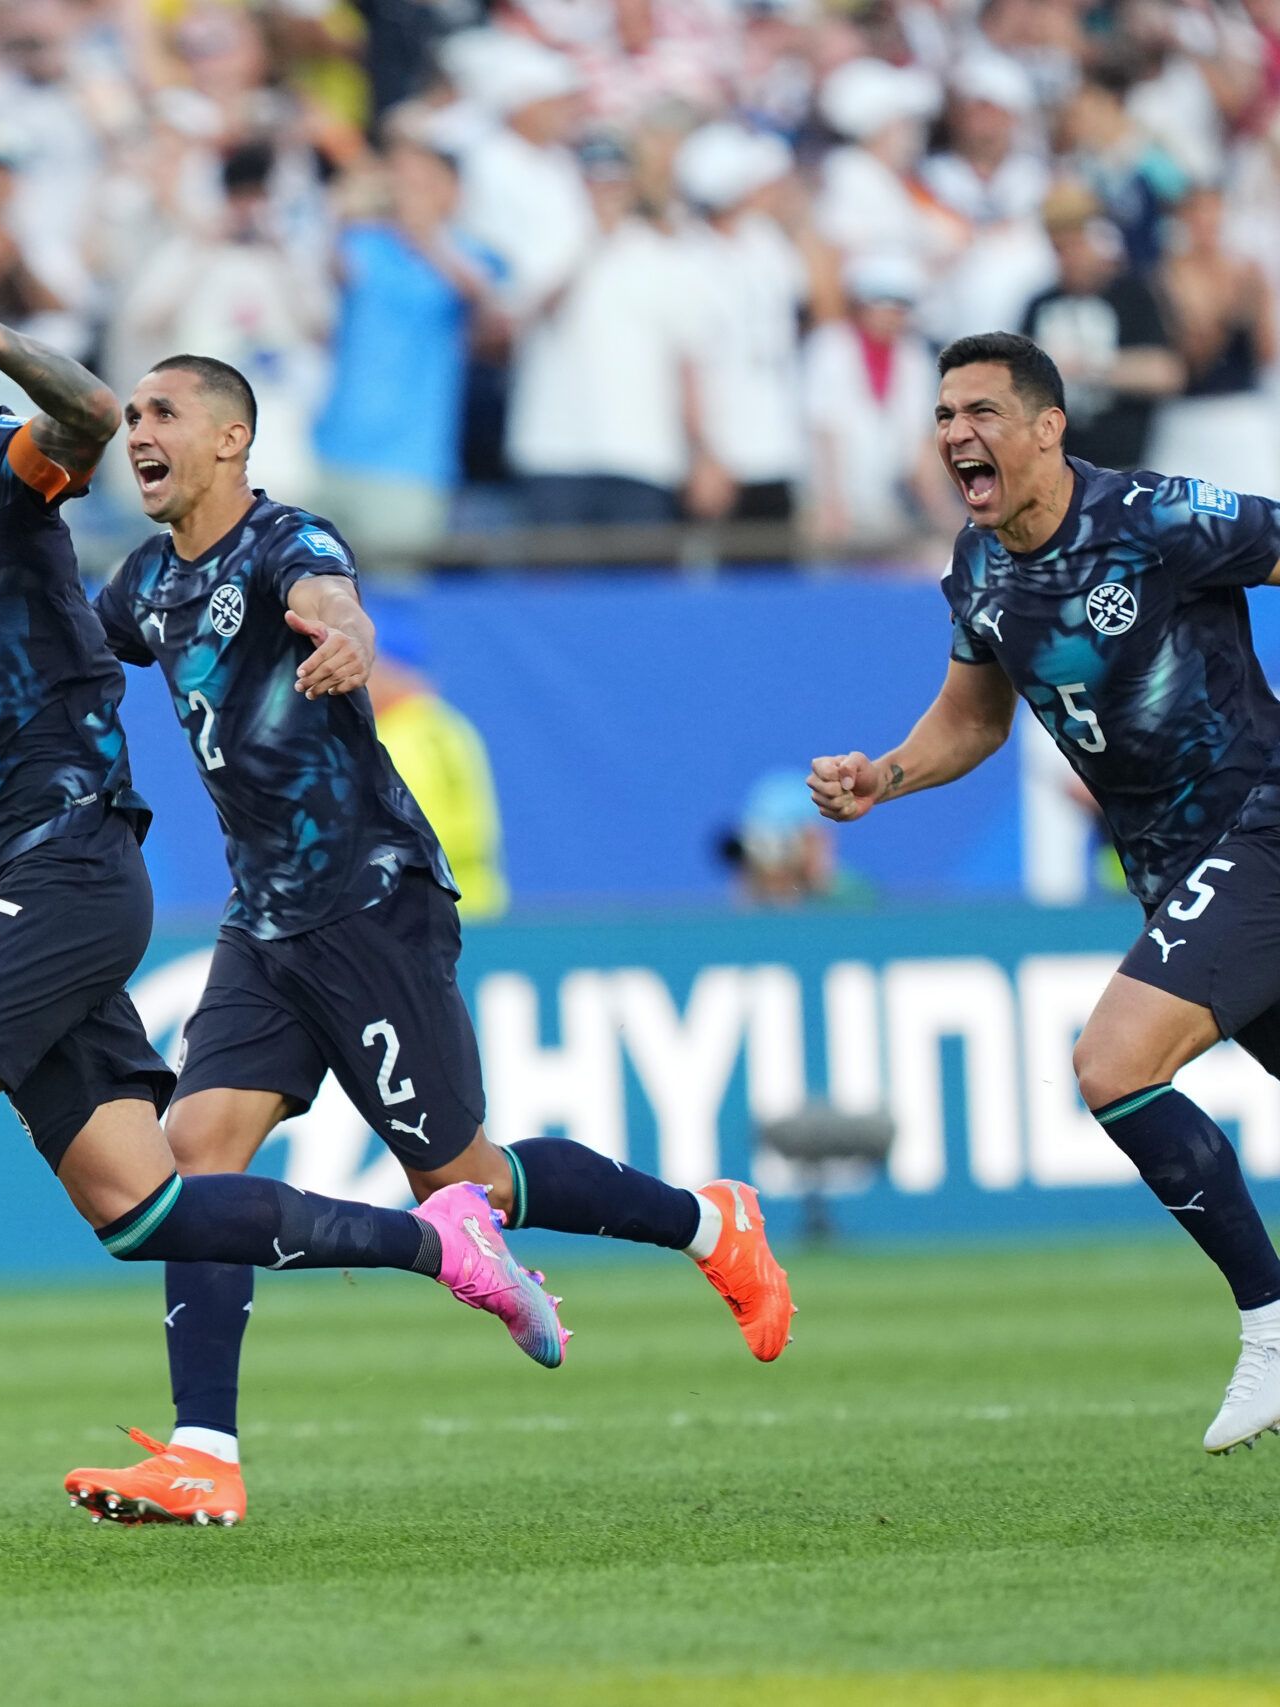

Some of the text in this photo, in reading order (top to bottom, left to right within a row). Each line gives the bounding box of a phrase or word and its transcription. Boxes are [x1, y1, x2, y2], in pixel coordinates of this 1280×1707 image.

[188, 689, 226, 771] 2
[1056, 682, 1107, 753] 5
[1167, 858, 1237, 922] 5
[361, 1018, 416, 1106] 2
